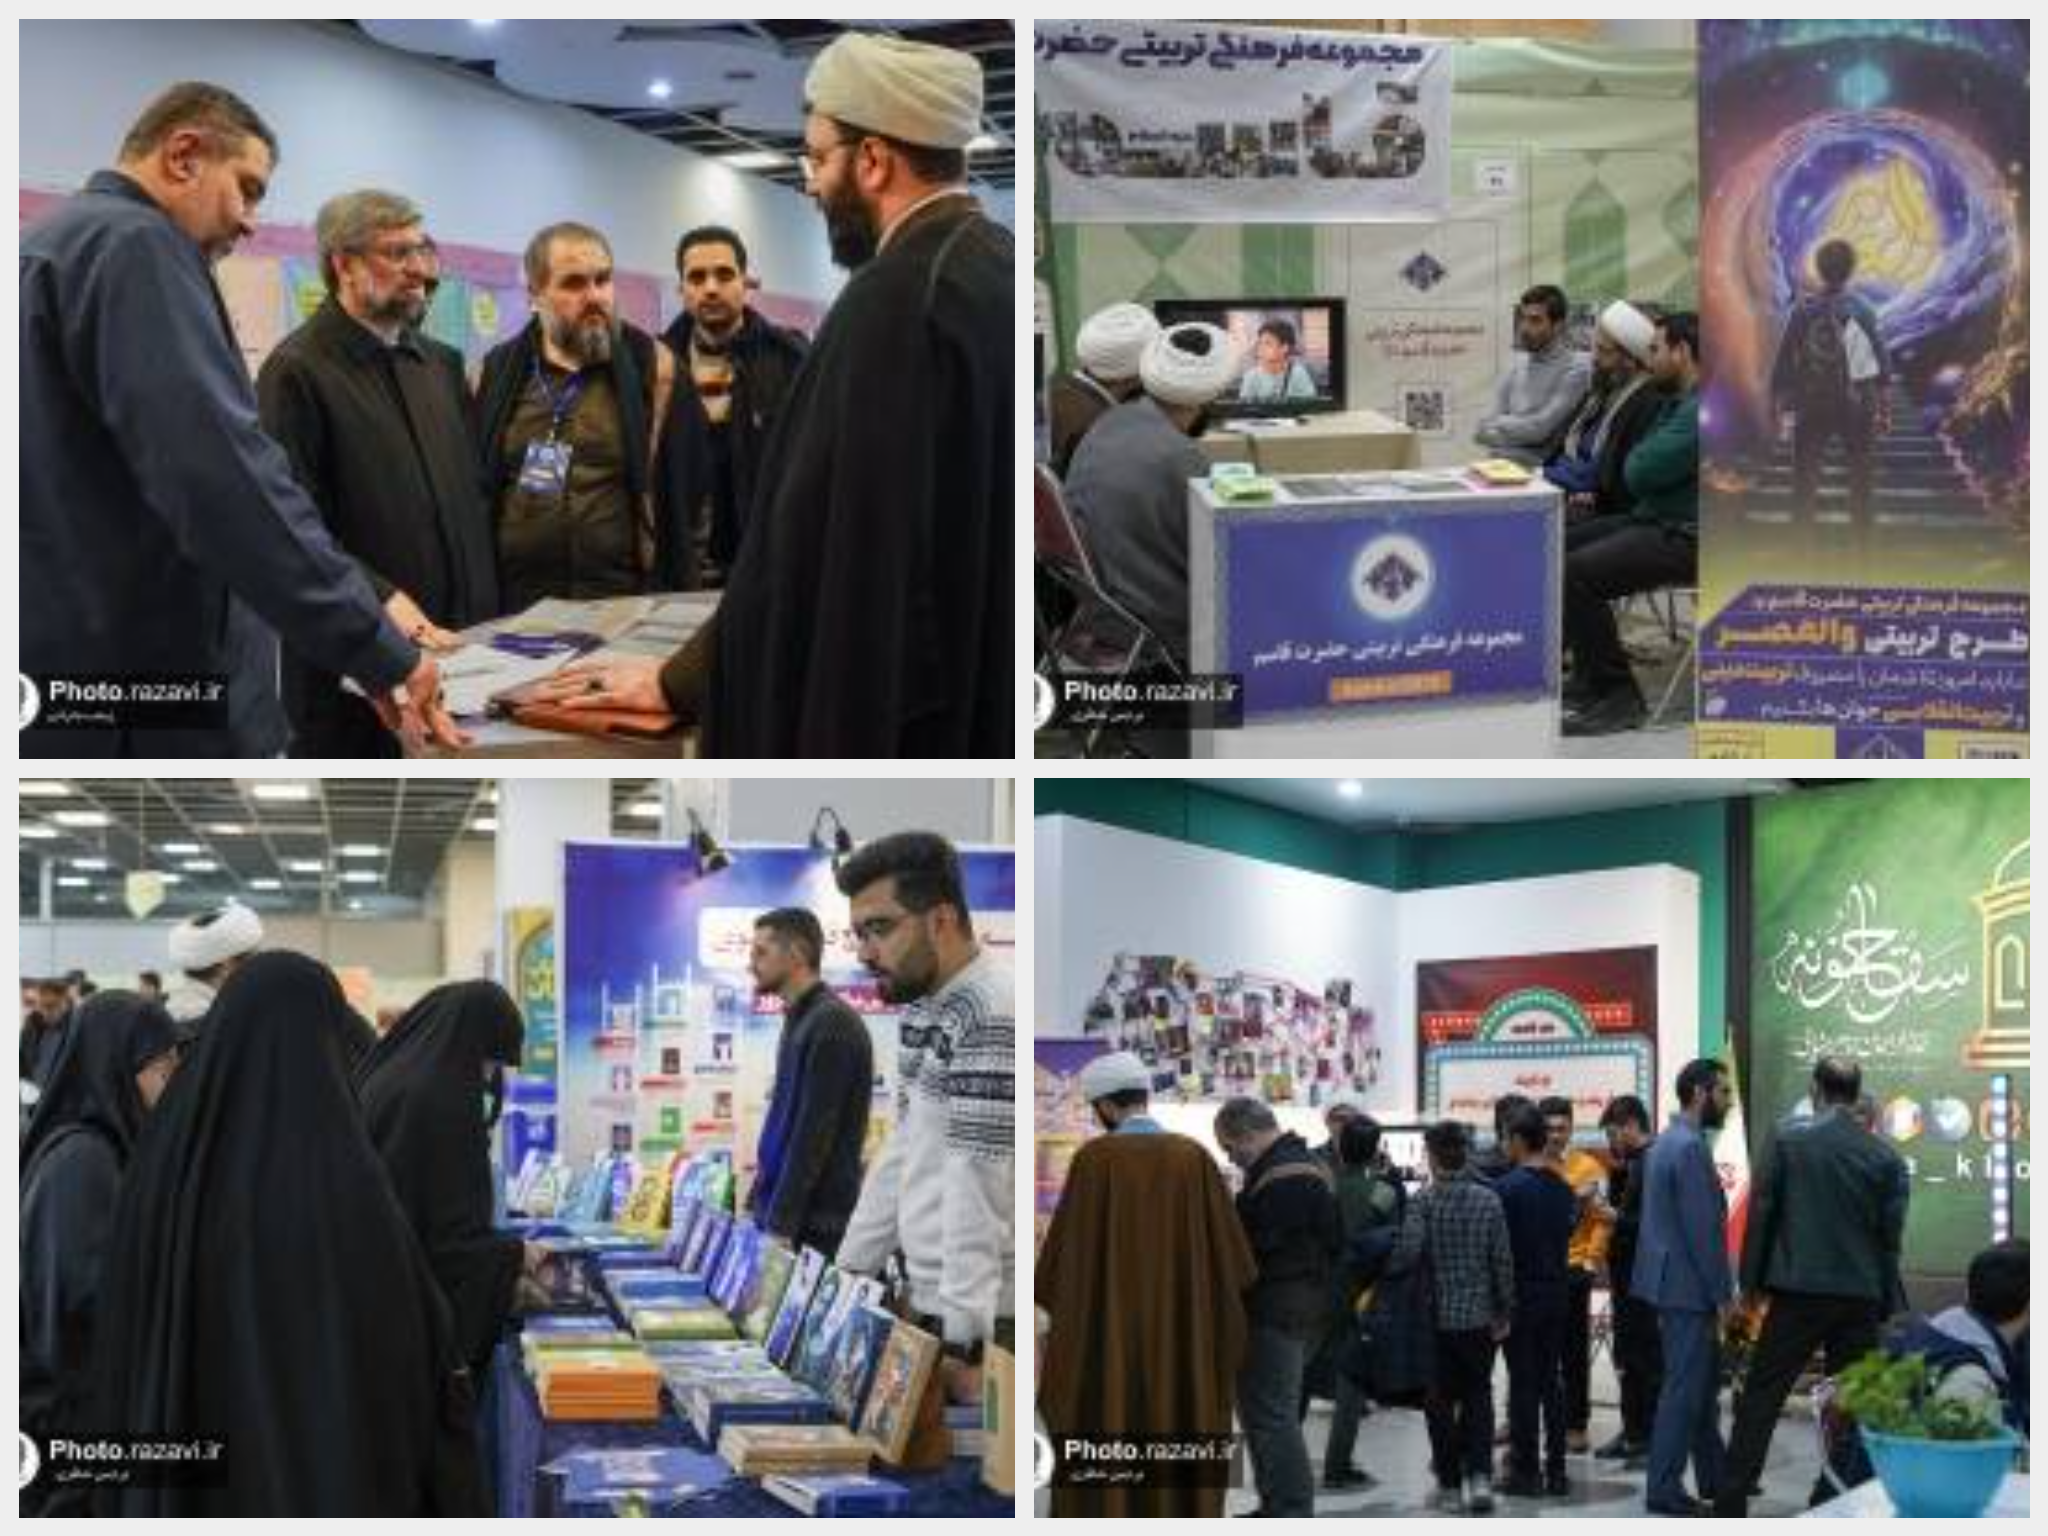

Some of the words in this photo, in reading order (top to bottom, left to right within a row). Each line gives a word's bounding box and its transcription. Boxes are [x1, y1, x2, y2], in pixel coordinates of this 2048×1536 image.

[1119, 29, 1207, 68] تربیتی
[1208, 31, 1304, 70] فرهنگی
[1306, 42, 1422, 72] مجموعه
[1864, 625, 1940, 657] تربیتی
[1949, 628, 2028, 660] طرح
